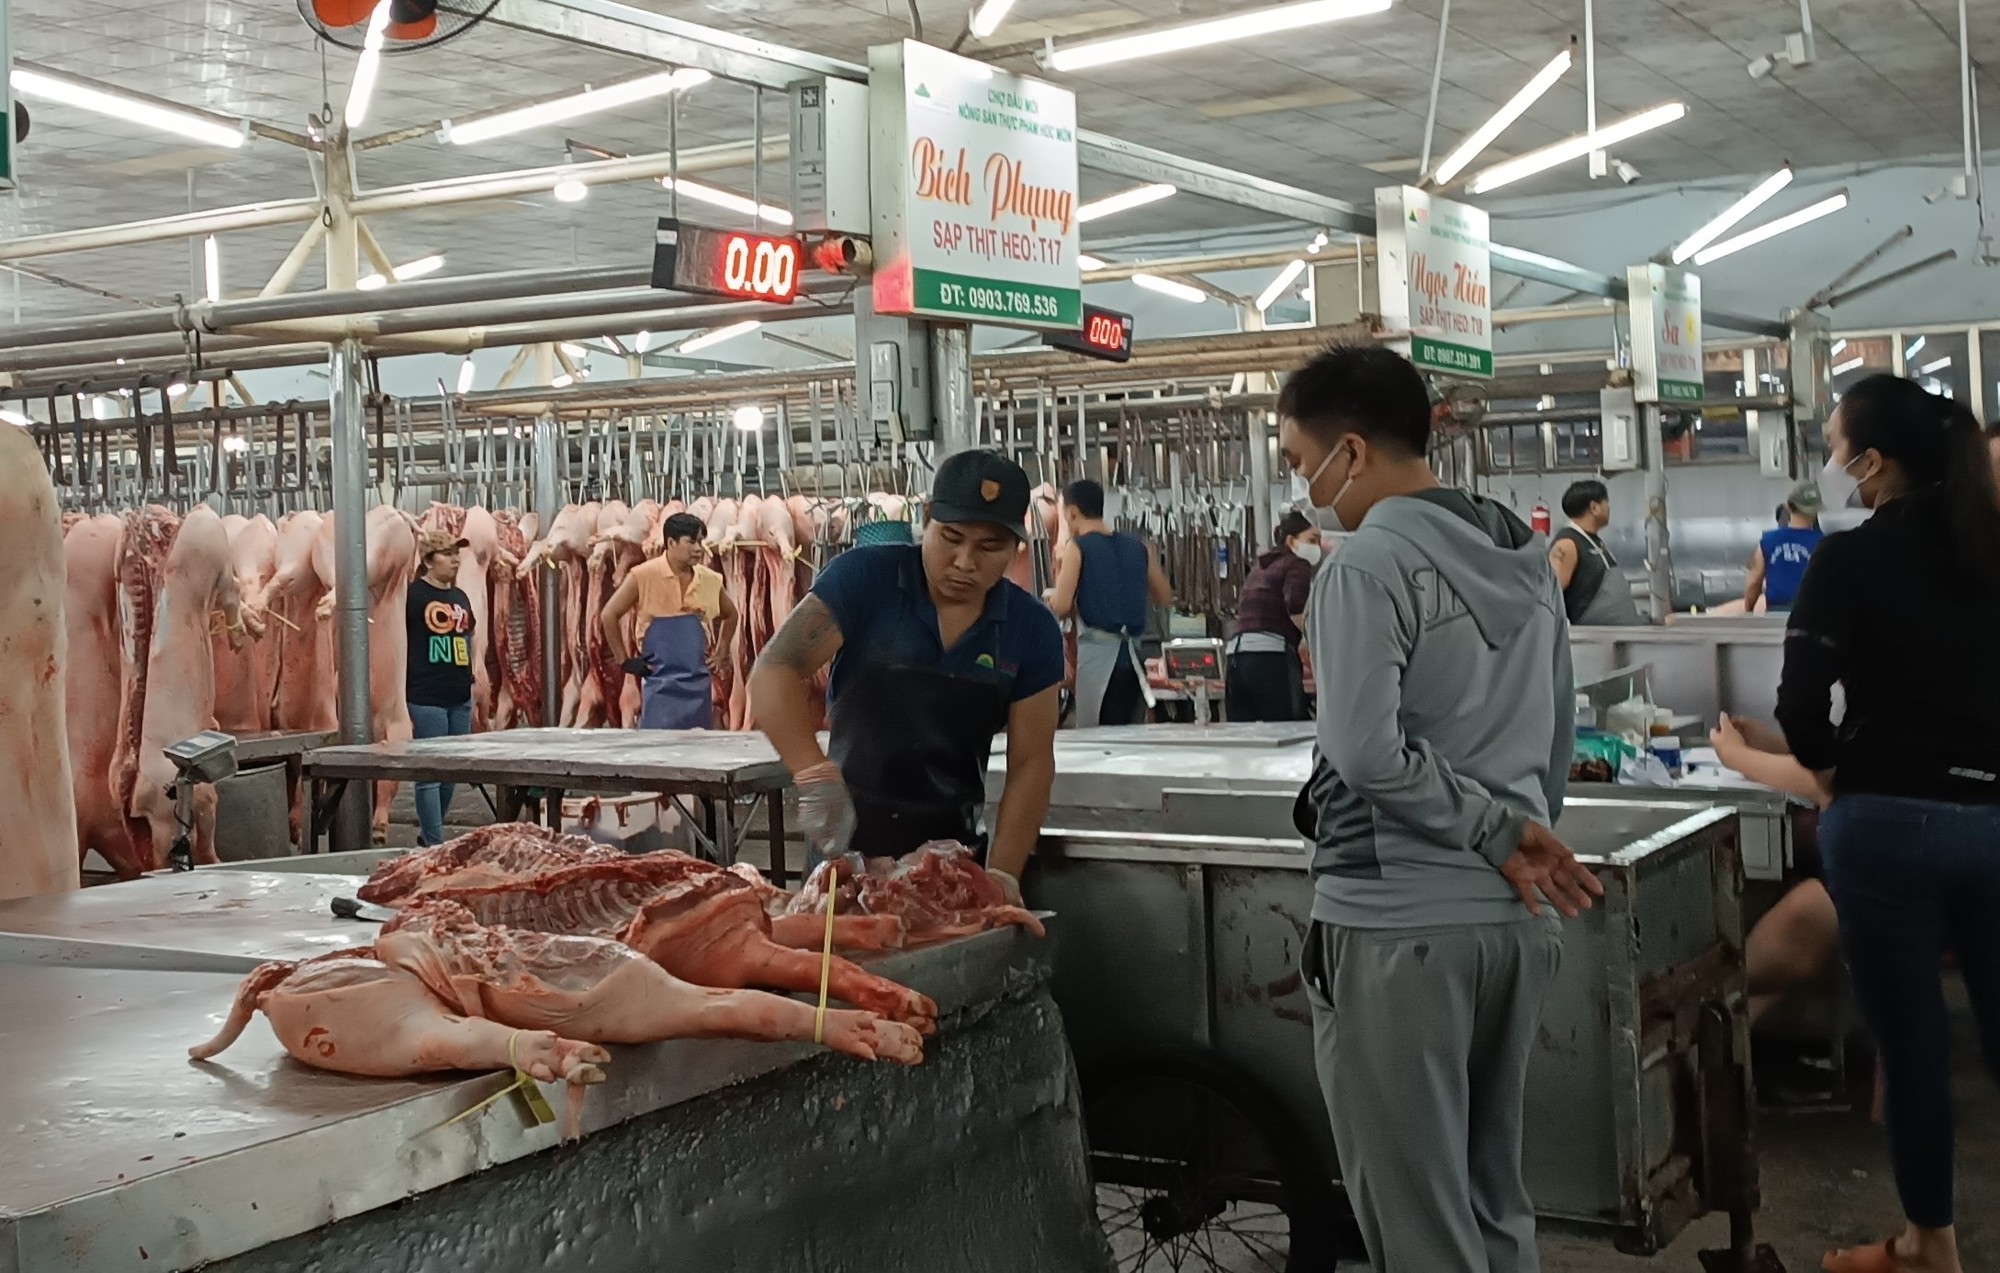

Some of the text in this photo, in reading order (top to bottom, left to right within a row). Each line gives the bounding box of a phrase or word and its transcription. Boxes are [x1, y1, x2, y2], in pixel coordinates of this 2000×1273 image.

[958, 102, 981, 121] NÔNG
[983, 152, 1073, 236] Phụng
[933, 219, 963, 256] SẠP
[966, 225, 998, 262] THỊT
[1039, 238, 1061, 265] T17
[724, 237, 795, 296] 0.00
[940, 283, 1058, 317] ĐT: 0903.769.536
[429, 635, 469, 666] NE
